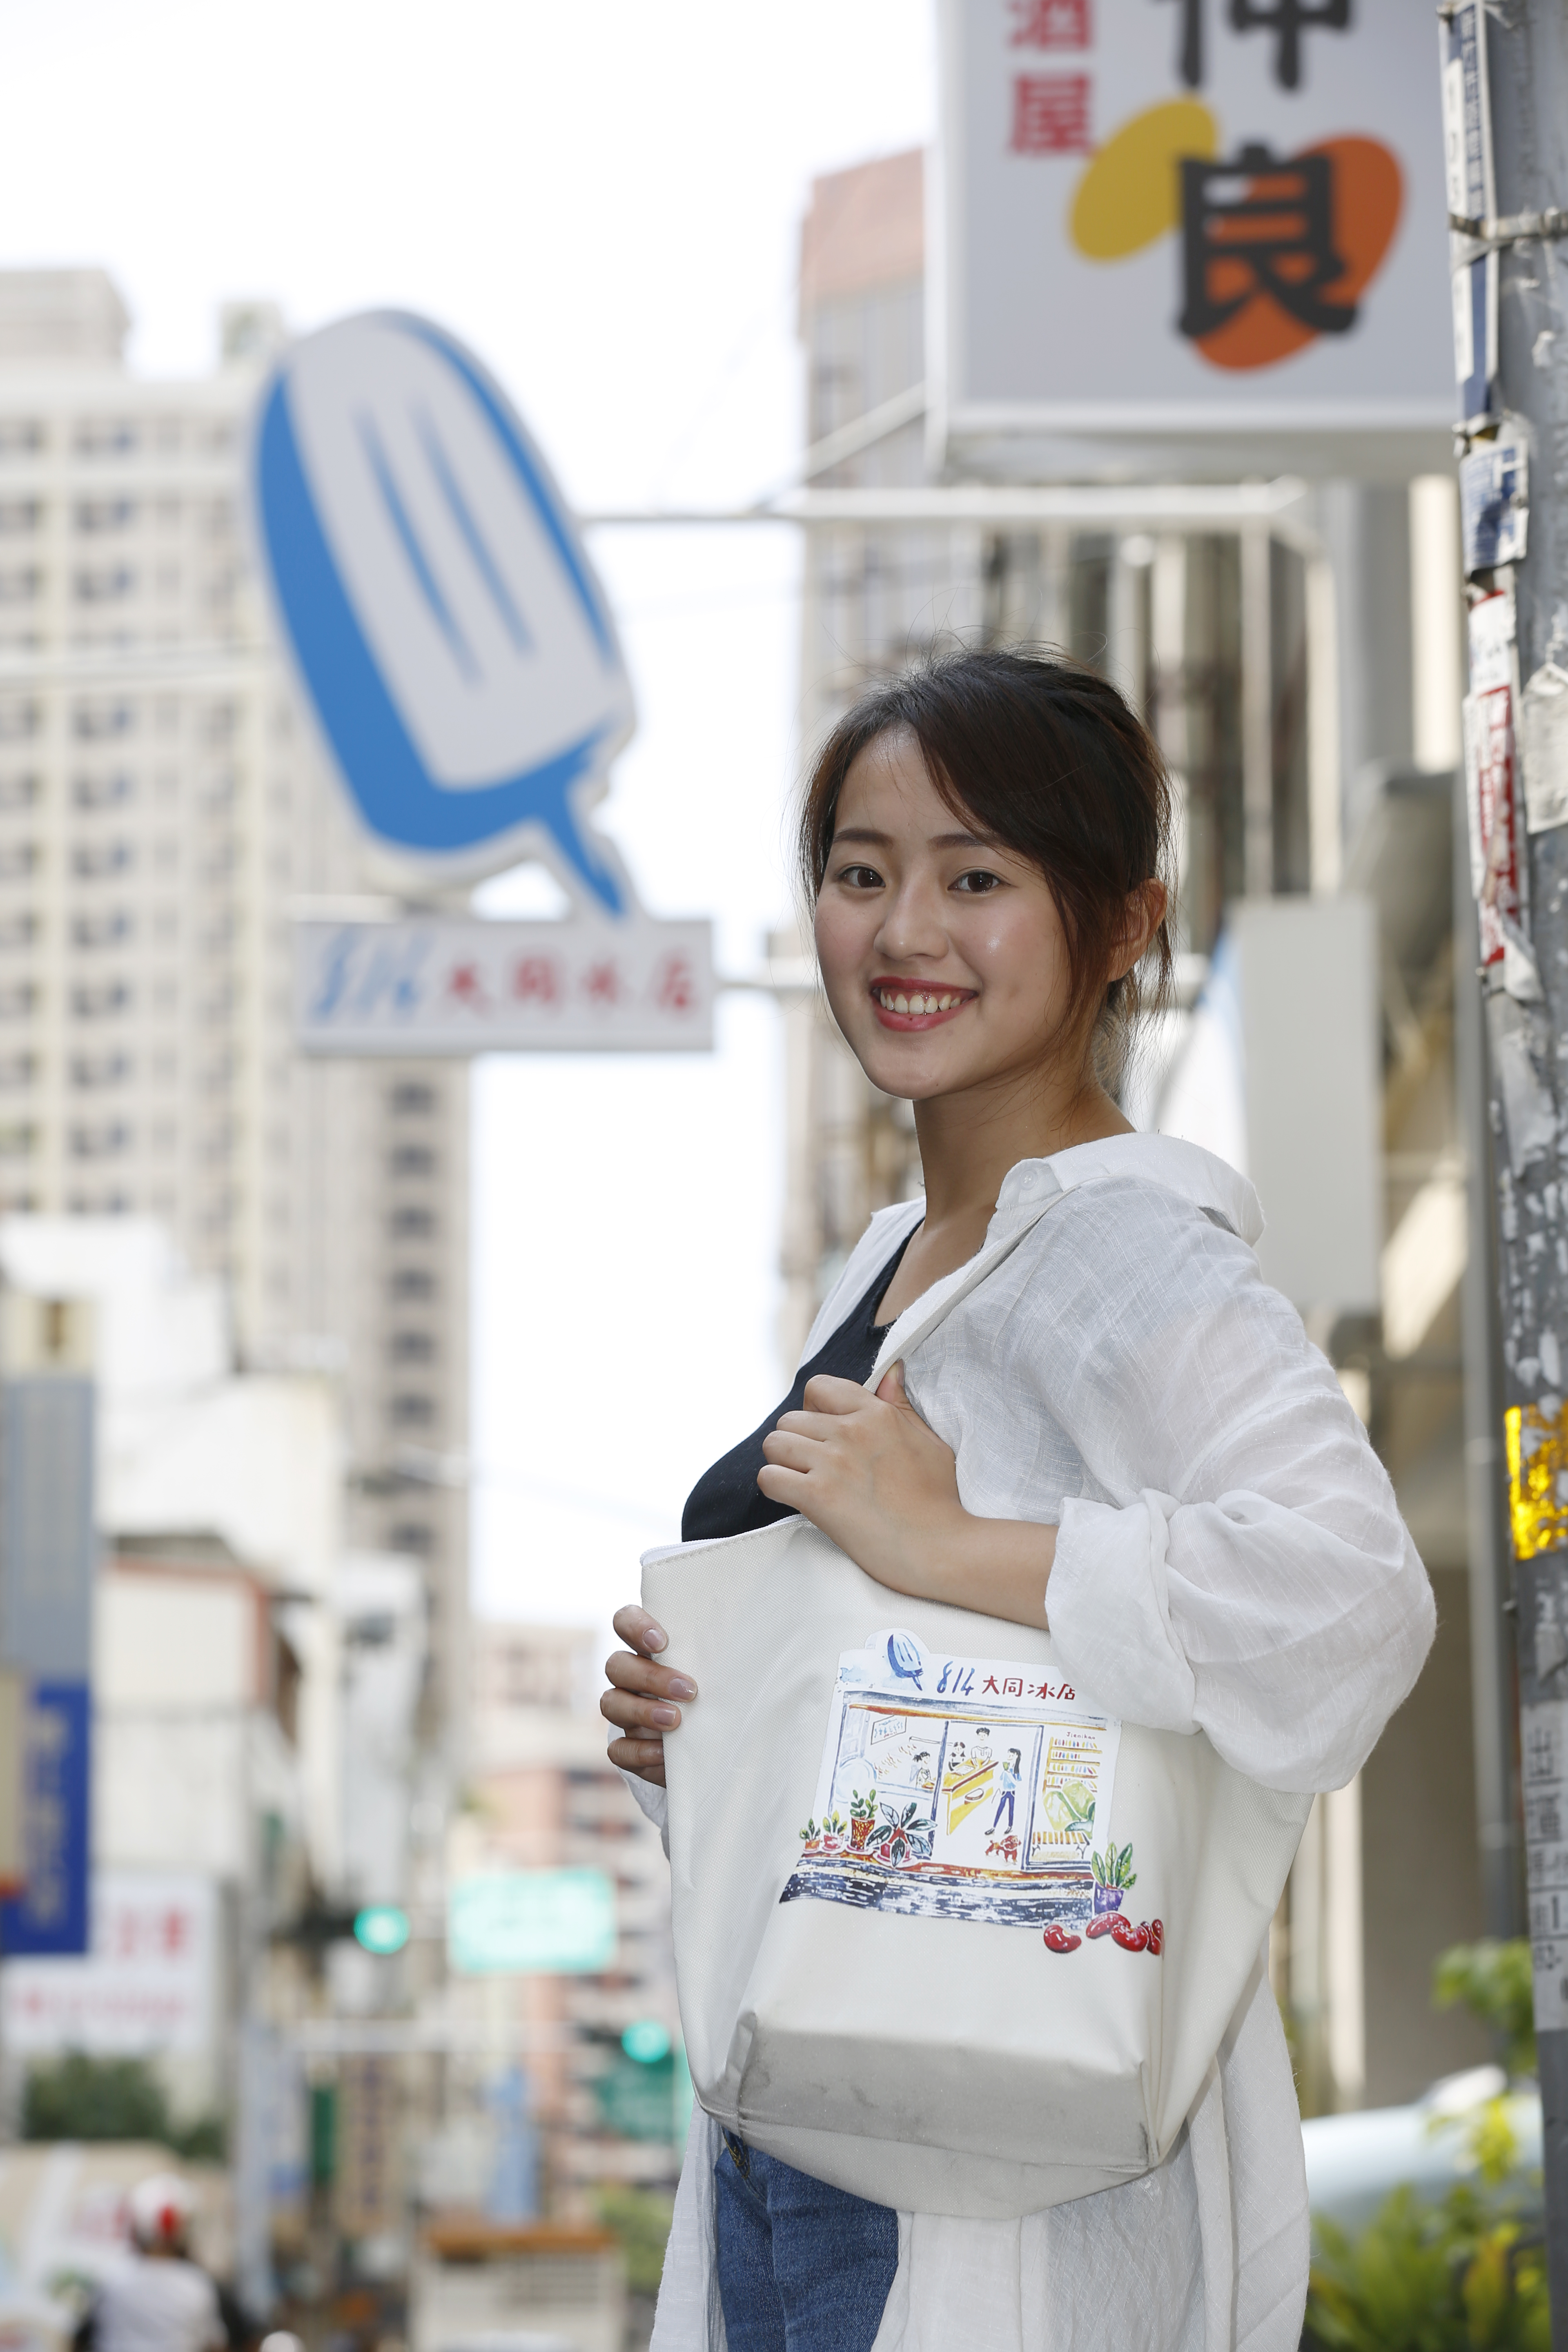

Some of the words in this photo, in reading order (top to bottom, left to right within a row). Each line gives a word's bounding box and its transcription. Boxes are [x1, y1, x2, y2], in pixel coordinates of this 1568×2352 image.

[937, 1661, 975, 1696] 814
[982, 1675, 1076, 1700] 大同冰店
